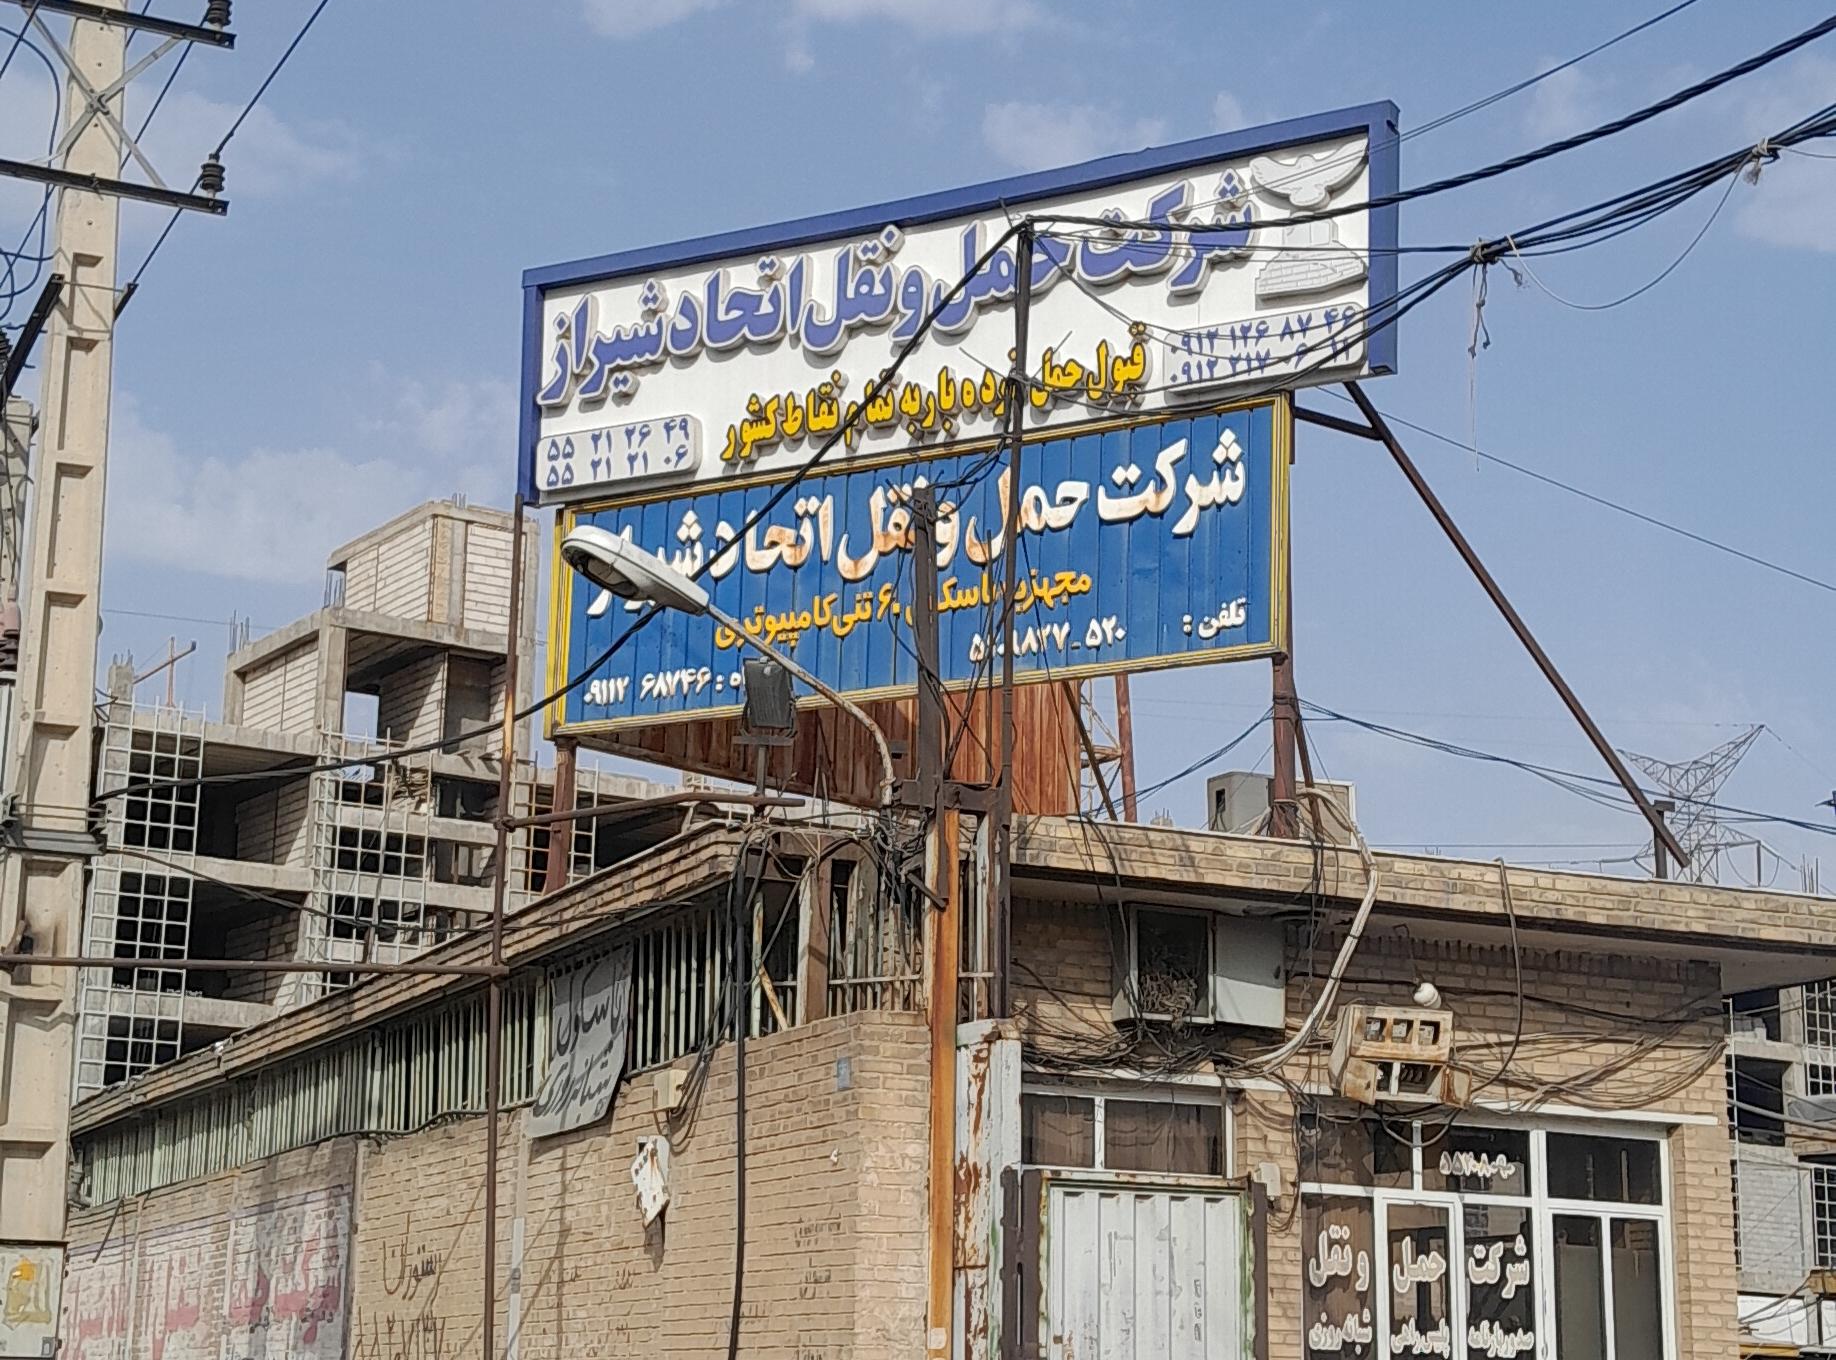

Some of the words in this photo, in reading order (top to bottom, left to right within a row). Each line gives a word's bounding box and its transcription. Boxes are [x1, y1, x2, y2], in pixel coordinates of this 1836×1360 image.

[1077, 167, 1254, 290] شرکت
[666, 251, 806, 356] اتحاد
[800, 223, 896, 351] نقل
[888, 264, 930, 340] و
[931, 219, 1075, 330] حمل
[537, 277, 668, 406] شیراز
[1280, 311, 1313, 342] ۸۷
[960, 347, 1020, 417] رده
[1030, 346, 1083, 408] حمل
[1086, 321, 1146, 403] قبول
[1170, 357, 1219, 385] ۰۹۱۲
[720, 392, 781, 461] کشور
[781, 369, 842, 437] نقاط
[843, 367, 895, 448] تمام
[547, 436, 575, 461] ۵۵
[590, 430, 612, 454] ۲۱
[624, 423, 652, 445] ۲۶
[664, 417, 690, 443] ۴۹
[547, 462, 575, 487] ۵۵
[590, 456, 611, 481] ۲۱
[626, 451, 648, 476] ۲۱
[664, 444, 689, 468] ۰۶
[965, 464, 1091, 564] حمل
[1097, 428, 1246, 536] شرکت
[709, 494, 835, 578] اتحاد
[640, 666, 712, 701] ۶۸۷۴۶
[1308, 1224, 1353, 1288] نقل
[1355, 1250, 1370, 1292] و
[1393, 1236, 1447, 1293] حمل
[1468, 1233, 1530, 1299] شرکت
